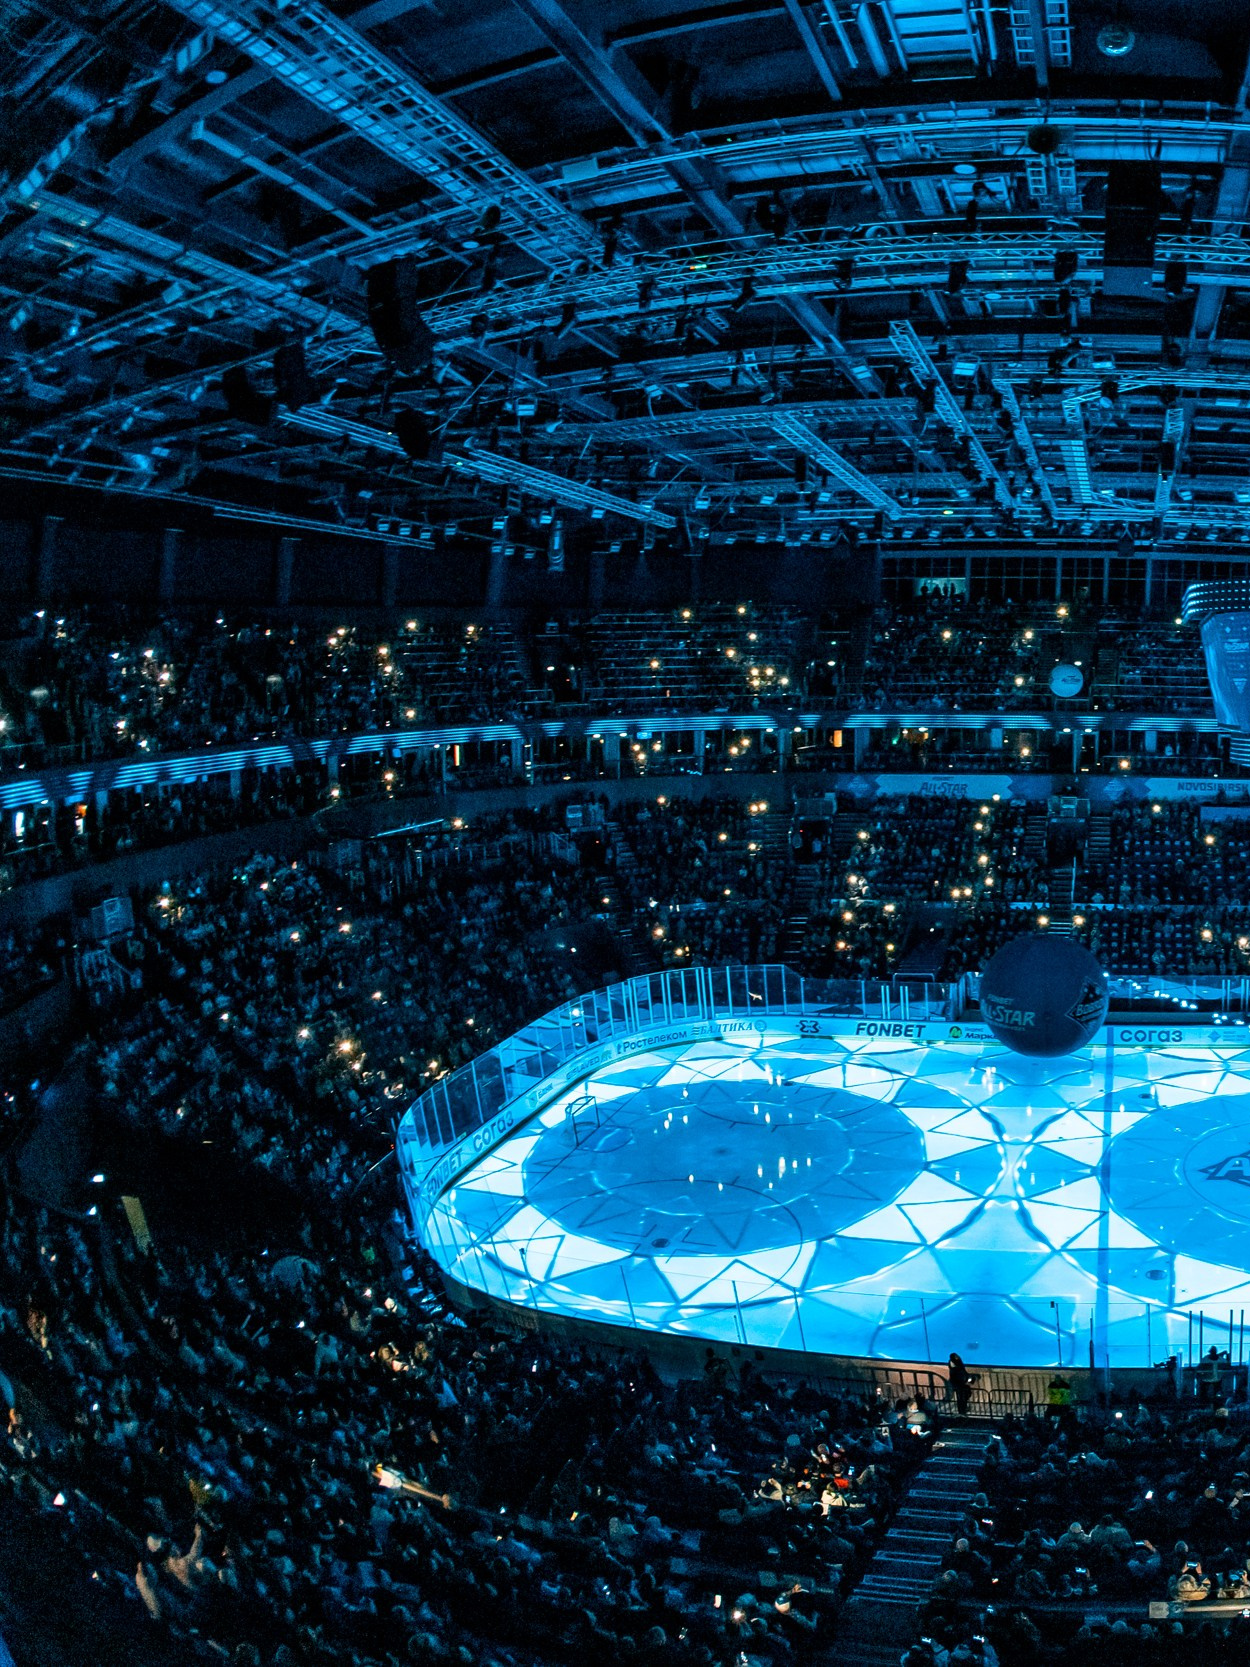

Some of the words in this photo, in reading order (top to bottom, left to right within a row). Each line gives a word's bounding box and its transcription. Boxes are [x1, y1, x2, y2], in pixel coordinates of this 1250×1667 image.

[1178, 782, 1248, 792] NOVOSIBIRSK
[700, 1021, 753, 1035] БАЛТИКА
[855, 1022, 926, 1038] FONBET
[623, 1029, 688, 1052] Ростелеком
